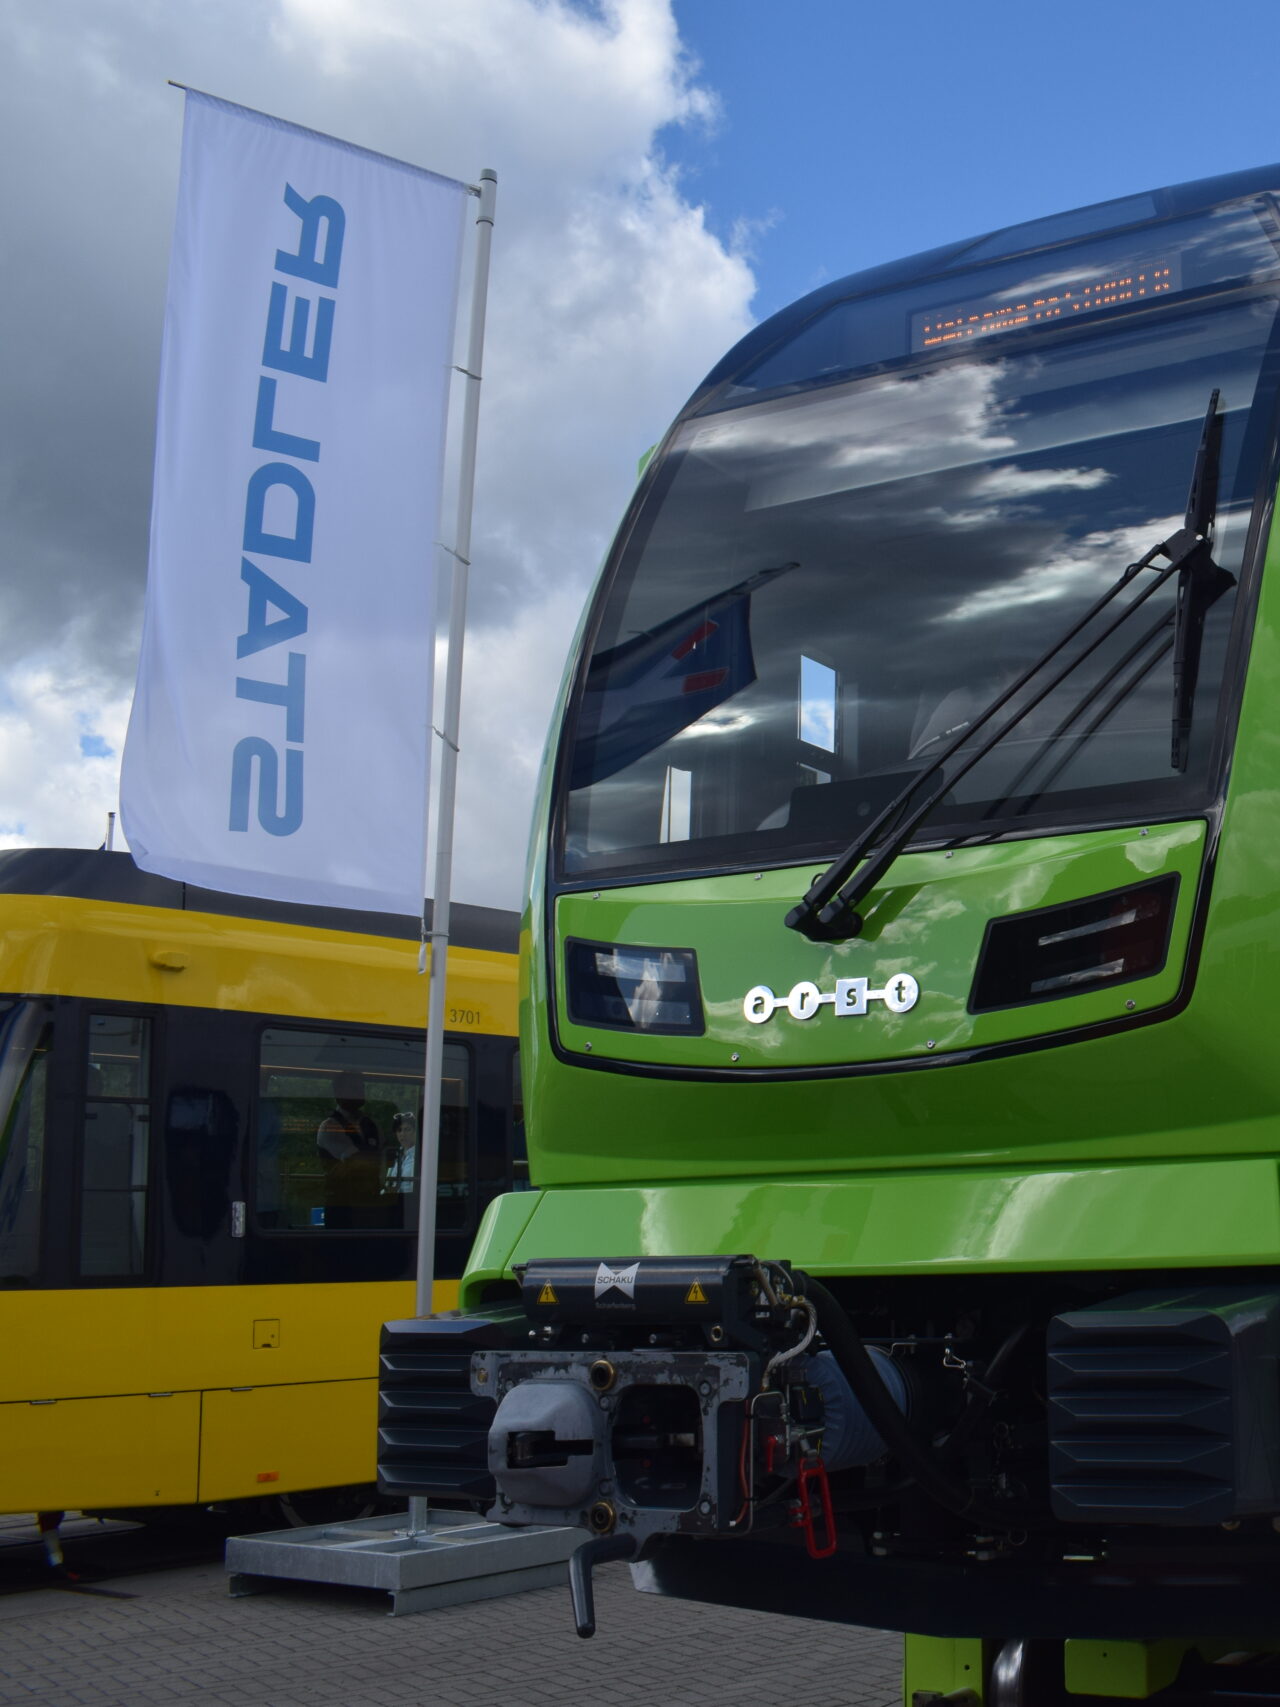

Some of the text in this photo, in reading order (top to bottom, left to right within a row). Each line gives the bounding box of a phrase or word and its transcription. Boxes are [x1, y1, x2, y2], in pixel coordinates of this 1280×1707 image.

[749, 978, 910, 1017] arst
[449, 1008, 480, 1025] 3701
[596, 1275, 634, 1284] SCHAKU
